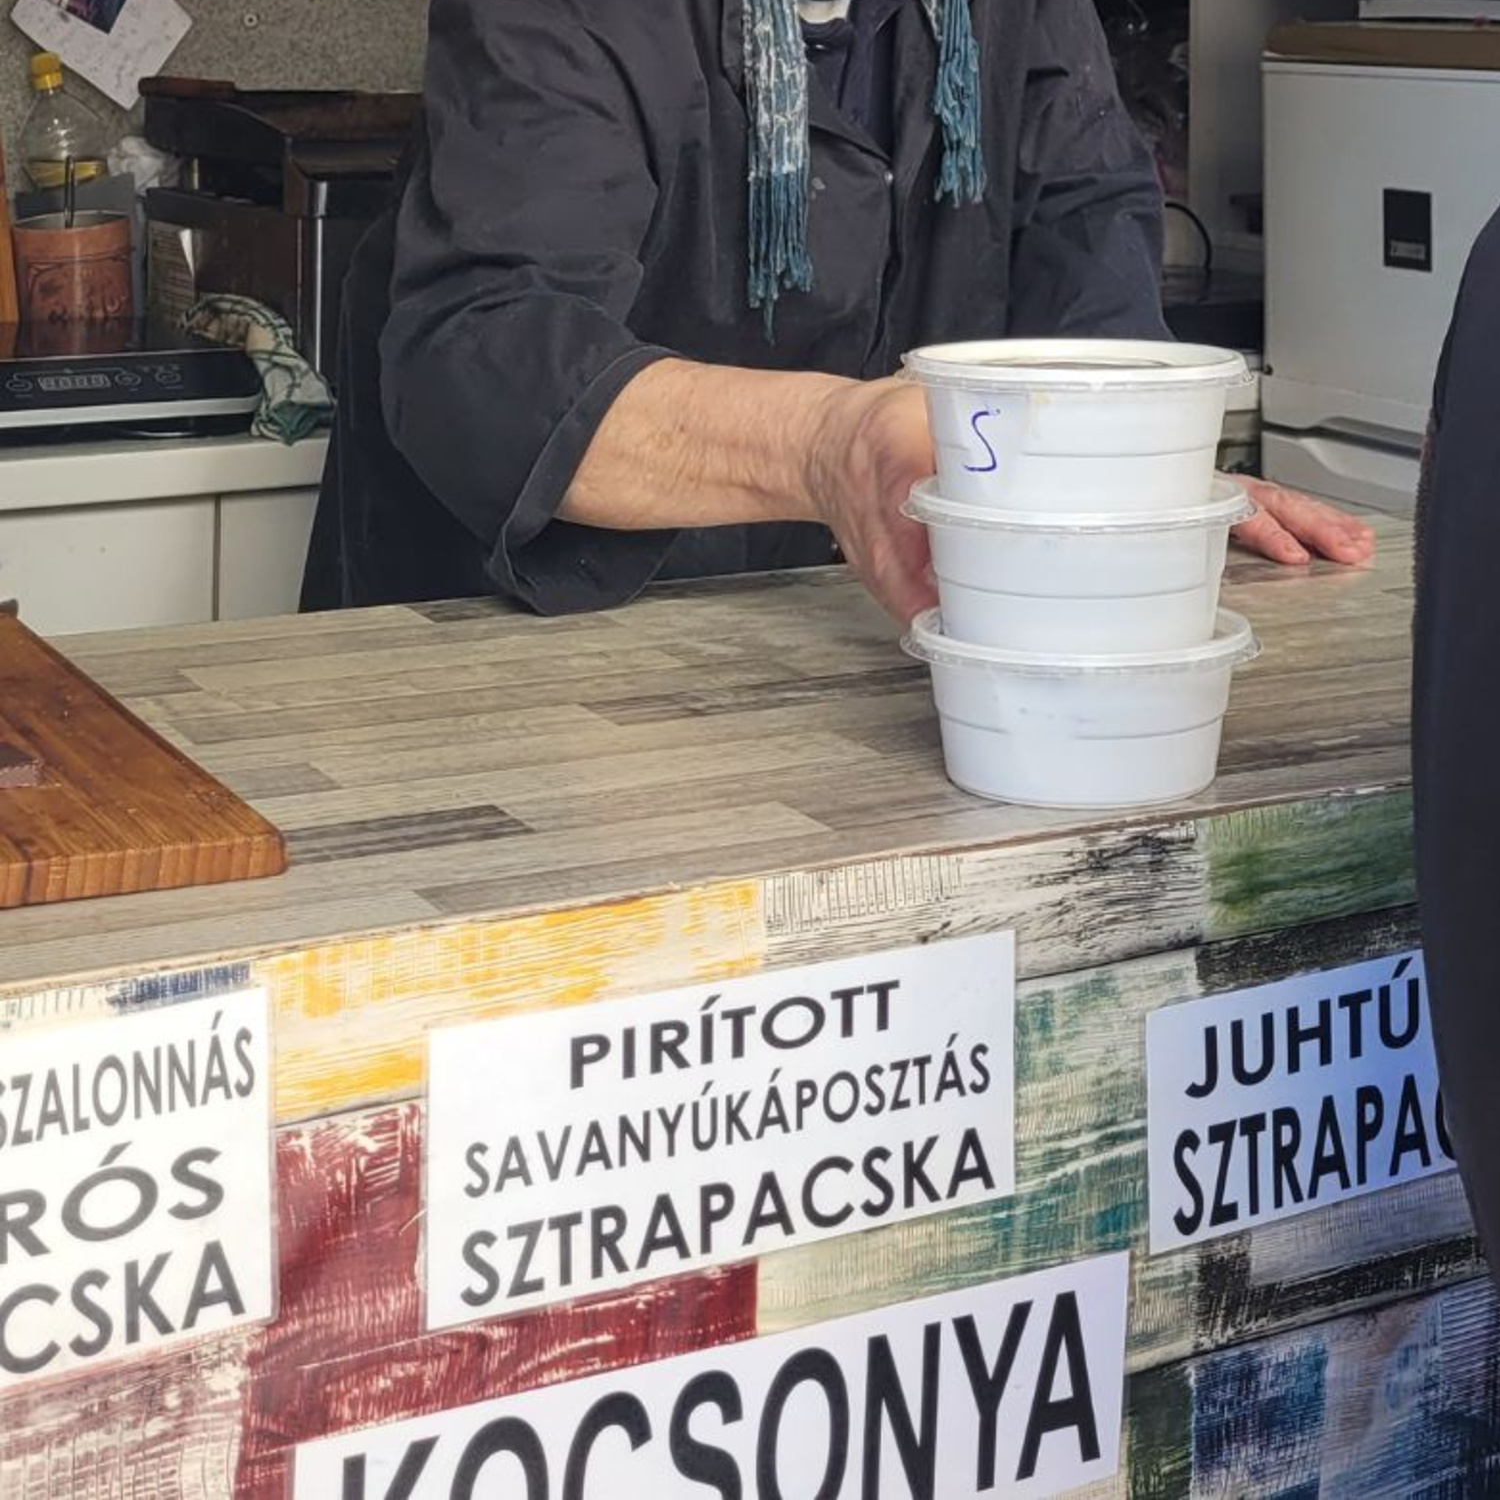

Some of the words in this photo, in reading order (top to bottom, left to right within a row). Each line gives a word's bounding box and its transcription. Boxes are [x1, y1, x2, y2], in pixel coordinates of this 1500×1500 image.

[463, 1032, 991, 1198] SAVANYÚKÁPOSZTÁS
[570, 979, 901, 1090] PIRÍTOTT
[460, 1127, 995, 1307] SZTRAPACSKA
